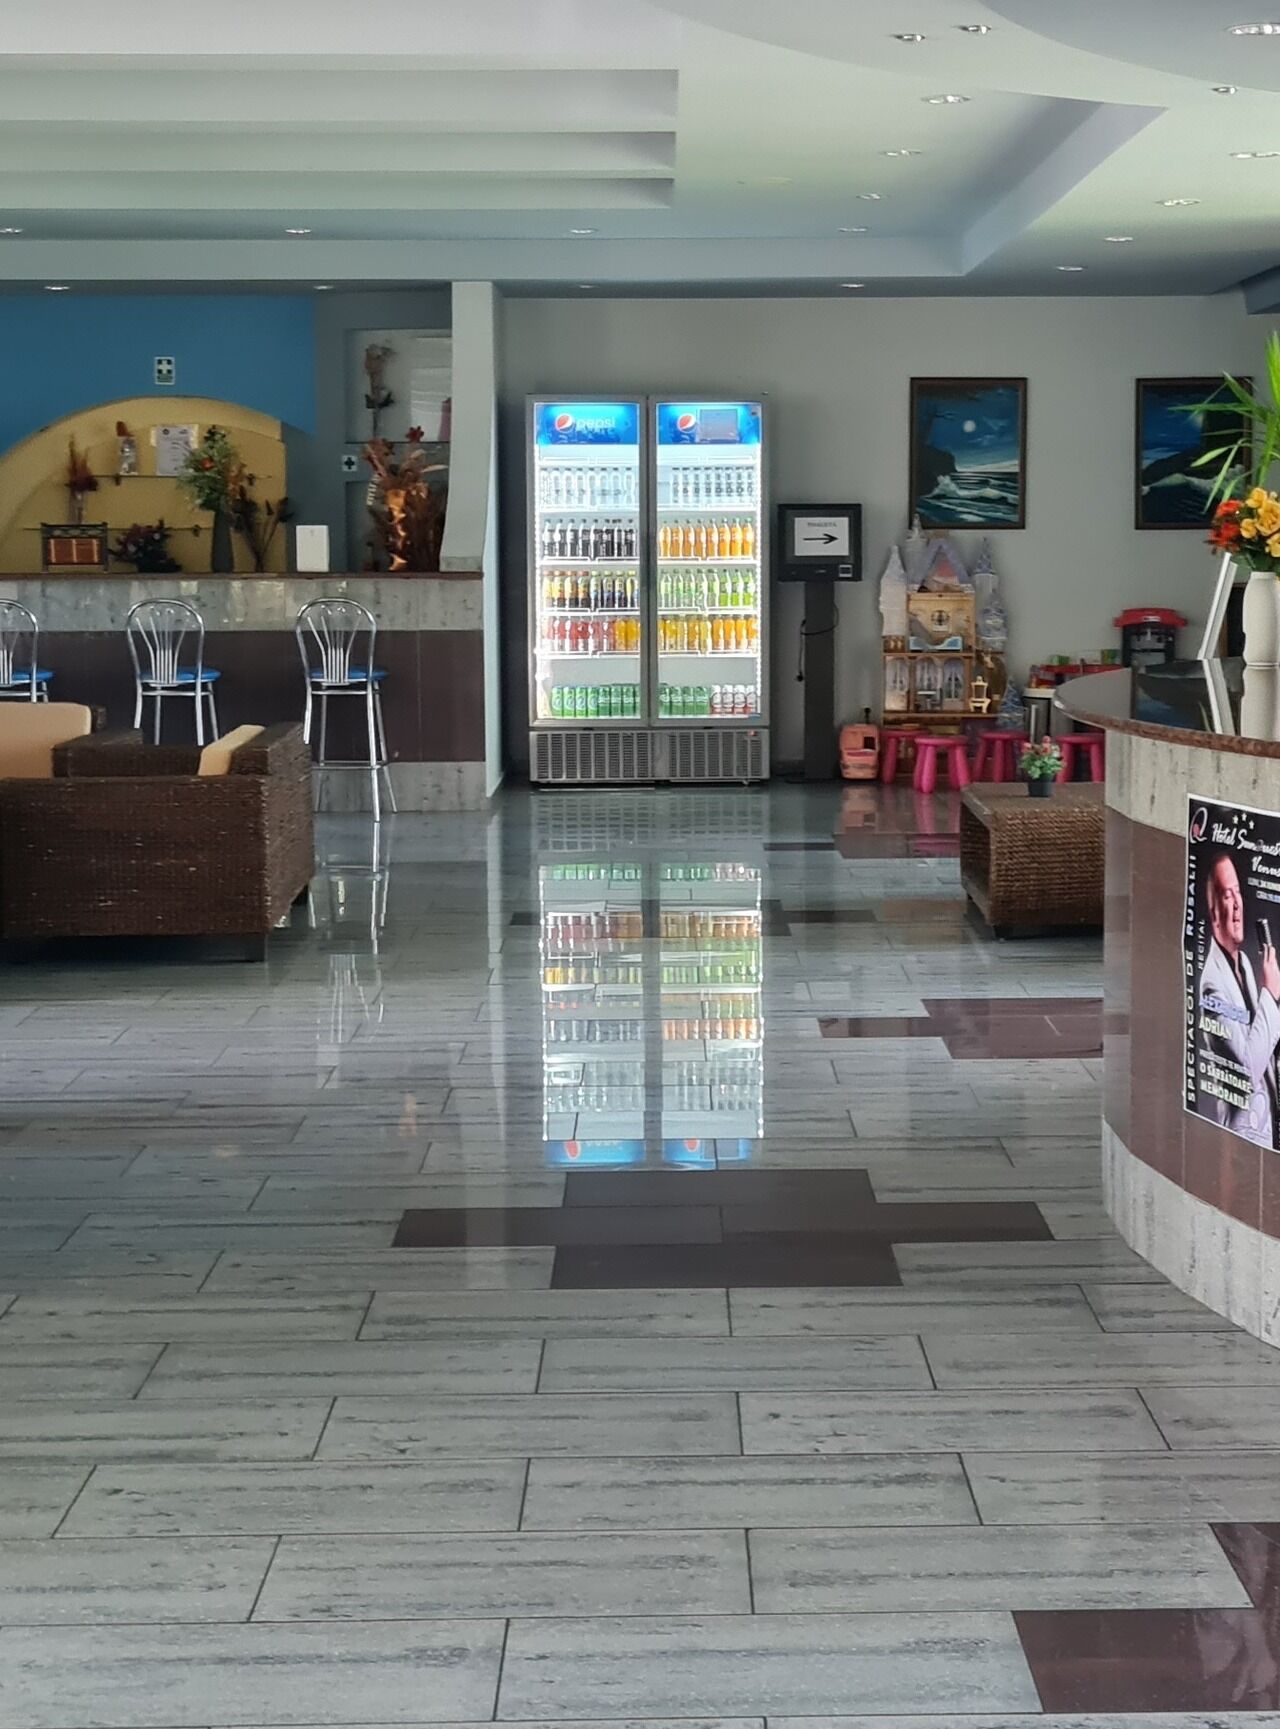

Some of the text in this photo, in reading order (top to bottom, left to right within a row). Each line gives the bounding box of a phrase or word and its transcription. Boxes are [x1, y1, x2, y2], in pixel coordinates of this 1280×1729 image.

[1211, 823, 1237, 846] Hotel
[1197, 919, 1206, 970] RECITAL
[1186, 951, 1195, 977] DE
[1186, 985, 1196, 1103] SPECTACOL
[1199, 1063, 1207, 1074] O
